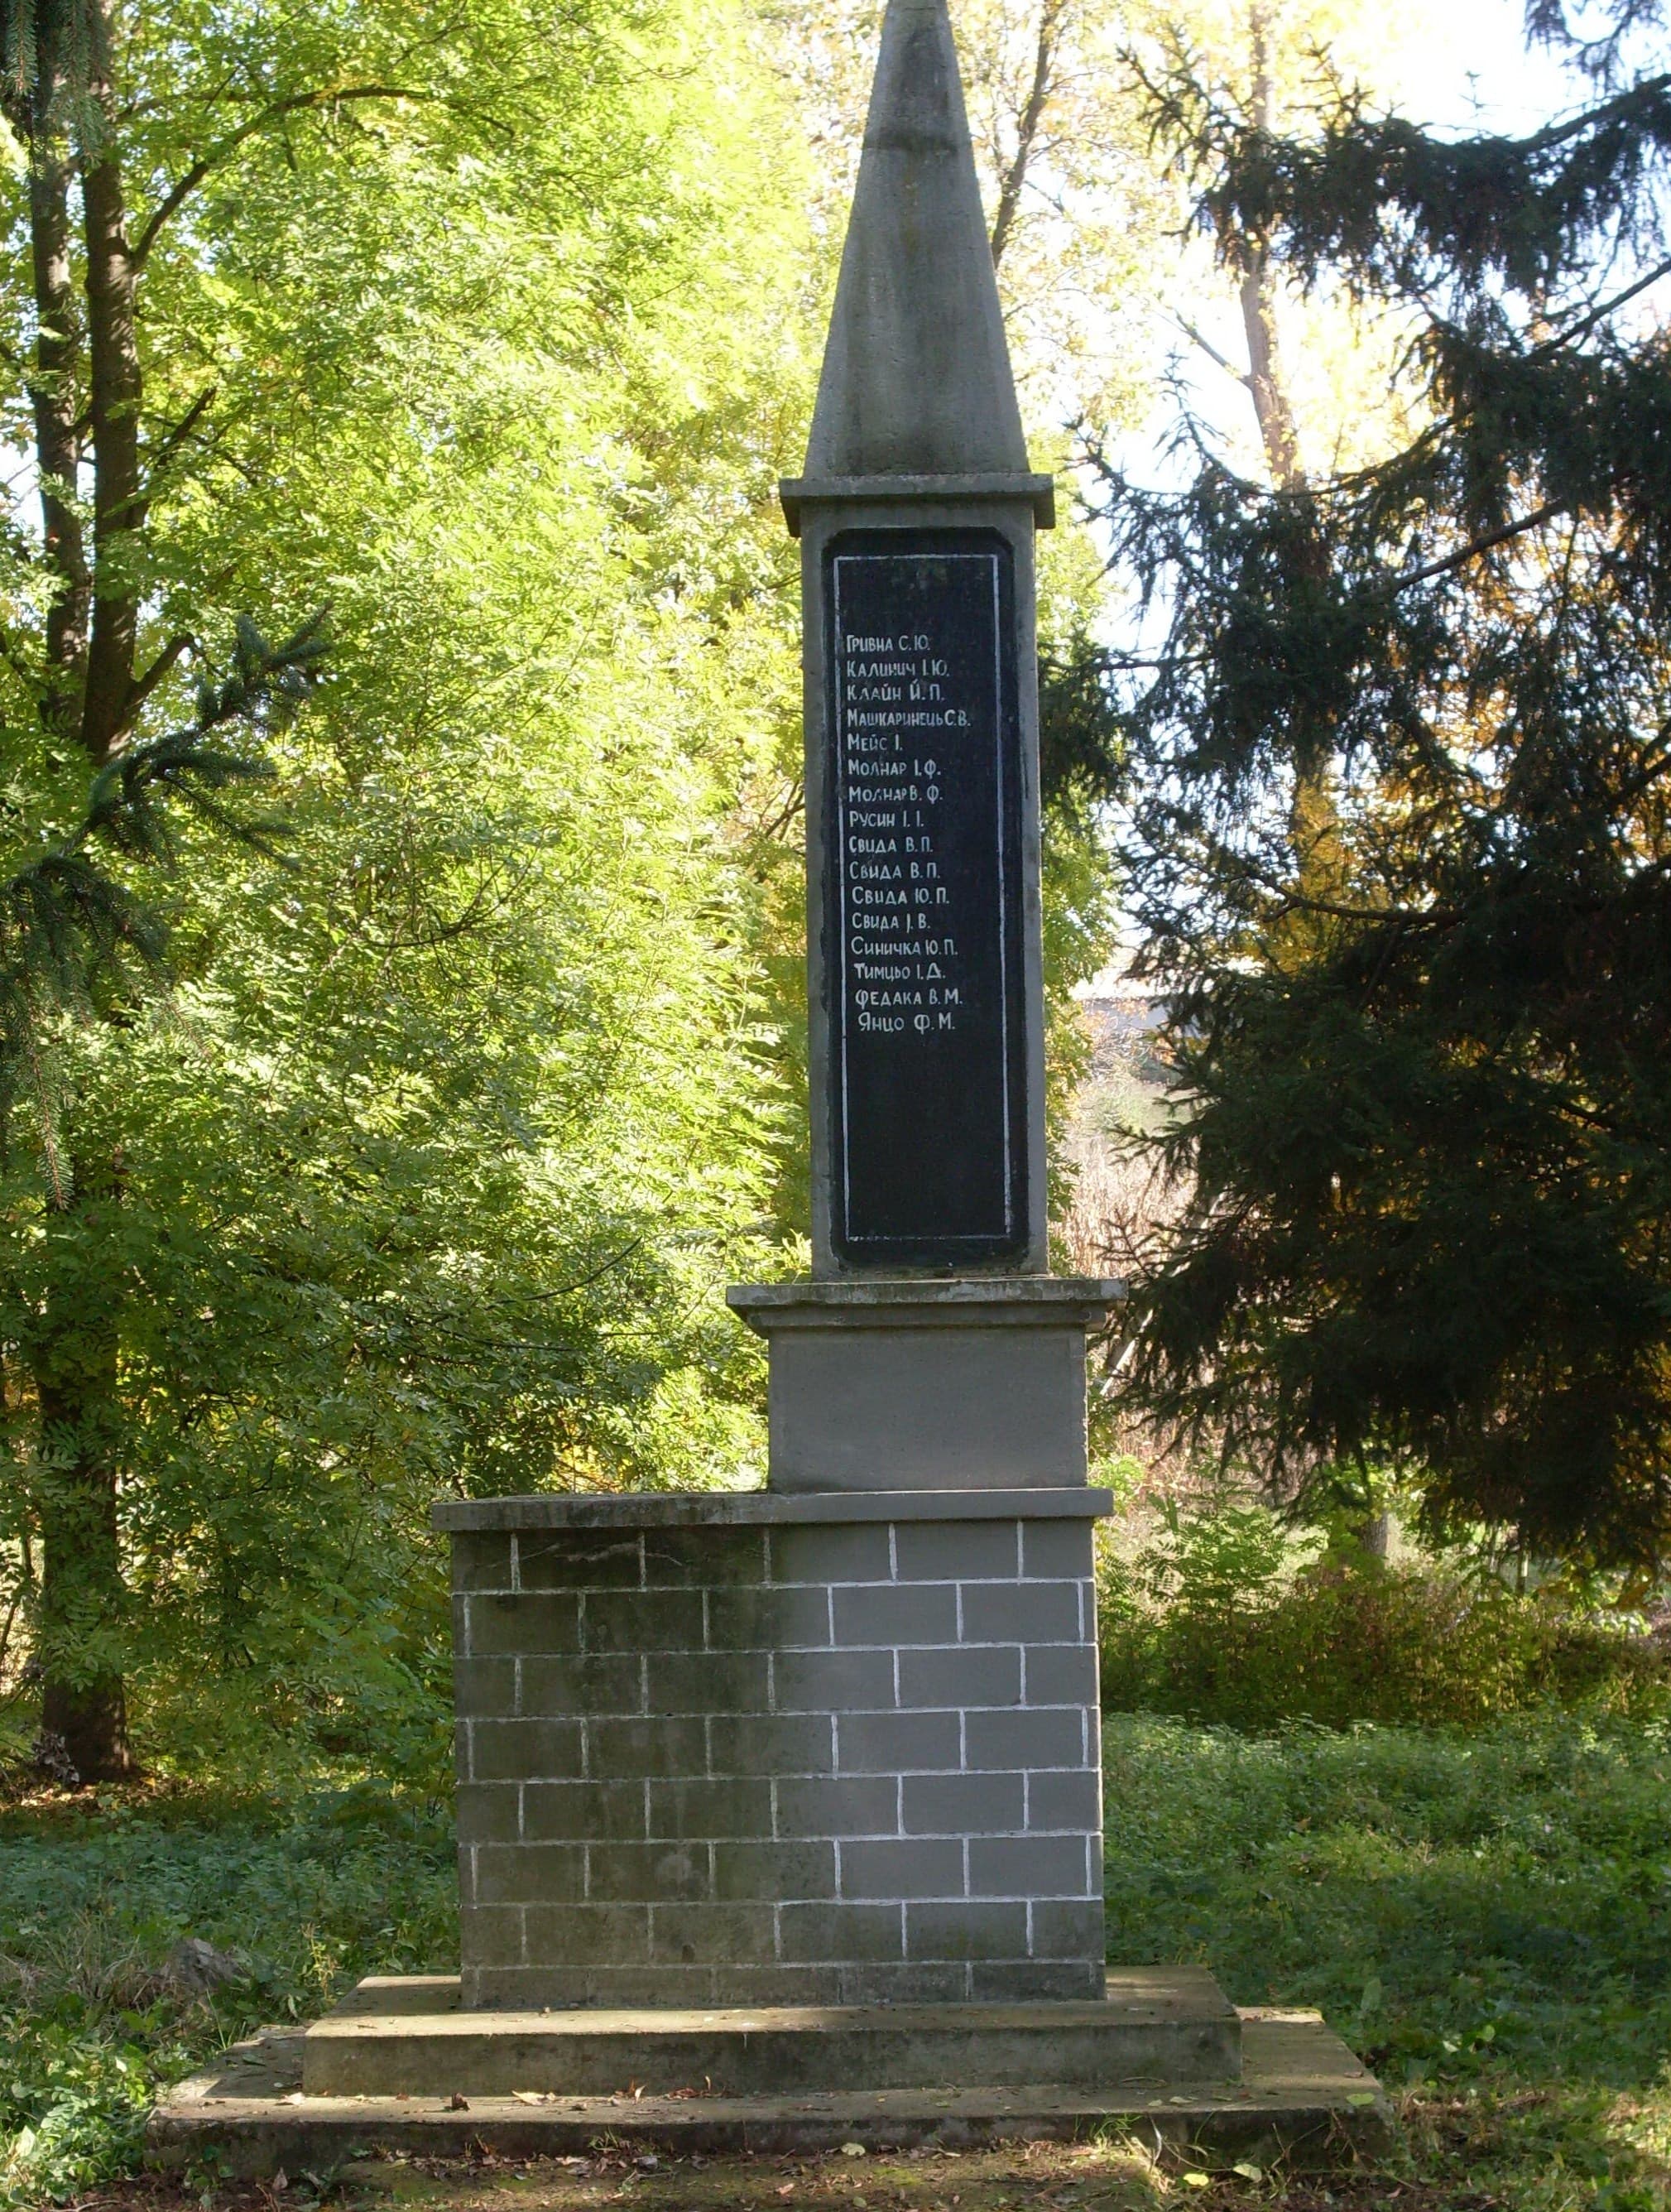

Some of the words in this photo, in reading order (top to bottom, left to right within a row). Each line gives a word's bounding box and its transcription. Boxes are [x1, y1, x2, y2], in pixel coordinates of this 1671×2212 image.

[847, 635, 893, 653] ГРИВНА
[847, 661, 915, 678] КАЛИНИЧ
[848, 683, 901, 701] КЛАЙН
[848, 733, 887, 752] МЕЙС
[848, 759, 906, 776] МОЛНАР
[848, 786, 906, 802] МОЛНАР
[849, 810, 895, 827] РУСИН
[849, 835, 897, 854] СВИДА
[849, 862, 902, 880] СВИДА
[852, 887, 907, 905] СВИДА
[852, 912, 899, 931] СВИДА
[851, 936, 921, 955] СИНИЧКА
[854, 963, 910, 982] ТИМЦЬО
[855, 988, 922, 1009] ФЕДАКА
[857, 1012, 905, 1033] ЯНЦО
